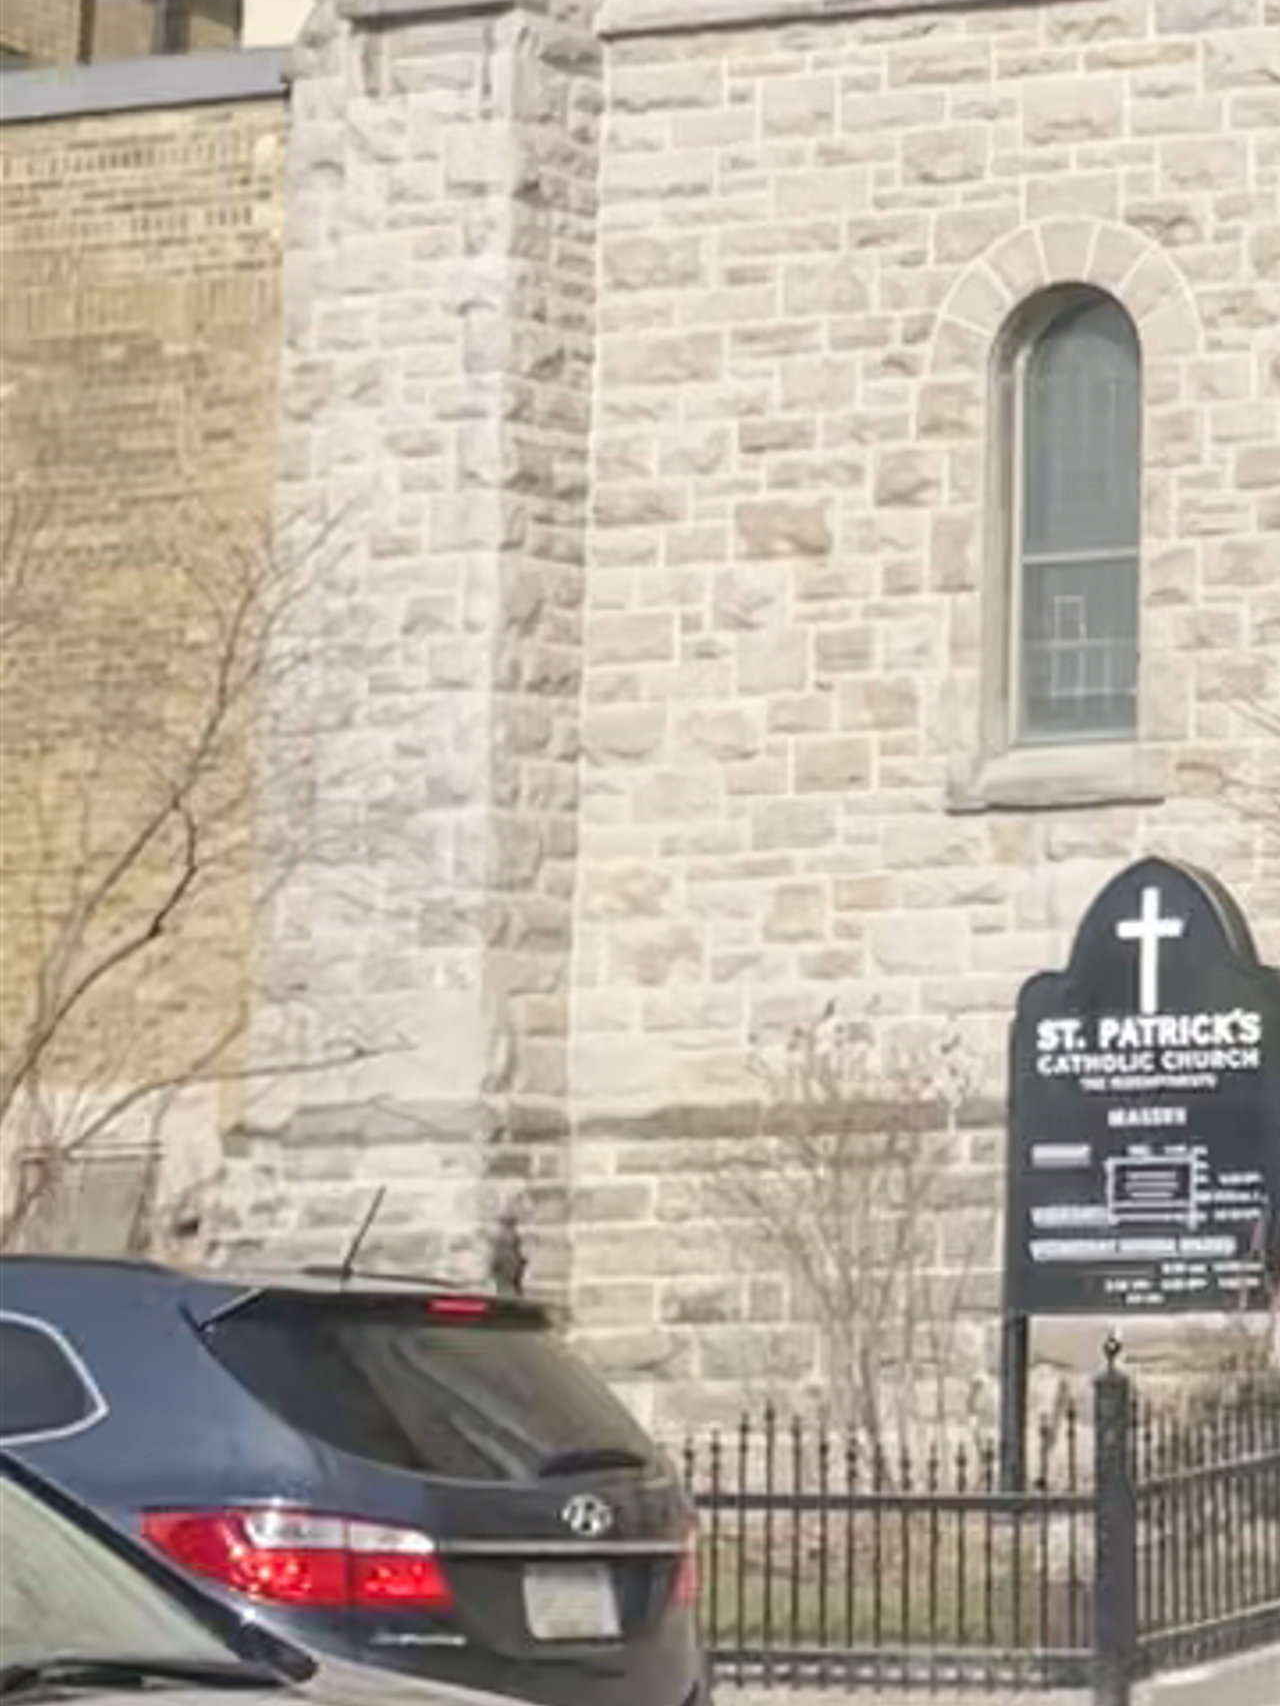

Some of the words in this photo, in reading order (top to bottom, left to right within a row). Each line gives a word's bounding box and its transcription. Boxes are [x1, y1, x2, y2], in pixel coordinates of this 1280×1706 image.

[1036, 1017, 1087, 1051] ST.
[1098, 1008, 1262, 1049] PATRICK'S
[1036, 1051, 1155, 1075] CATHOLIC
[1160, 1047, 1260, 1071] CHURCH
